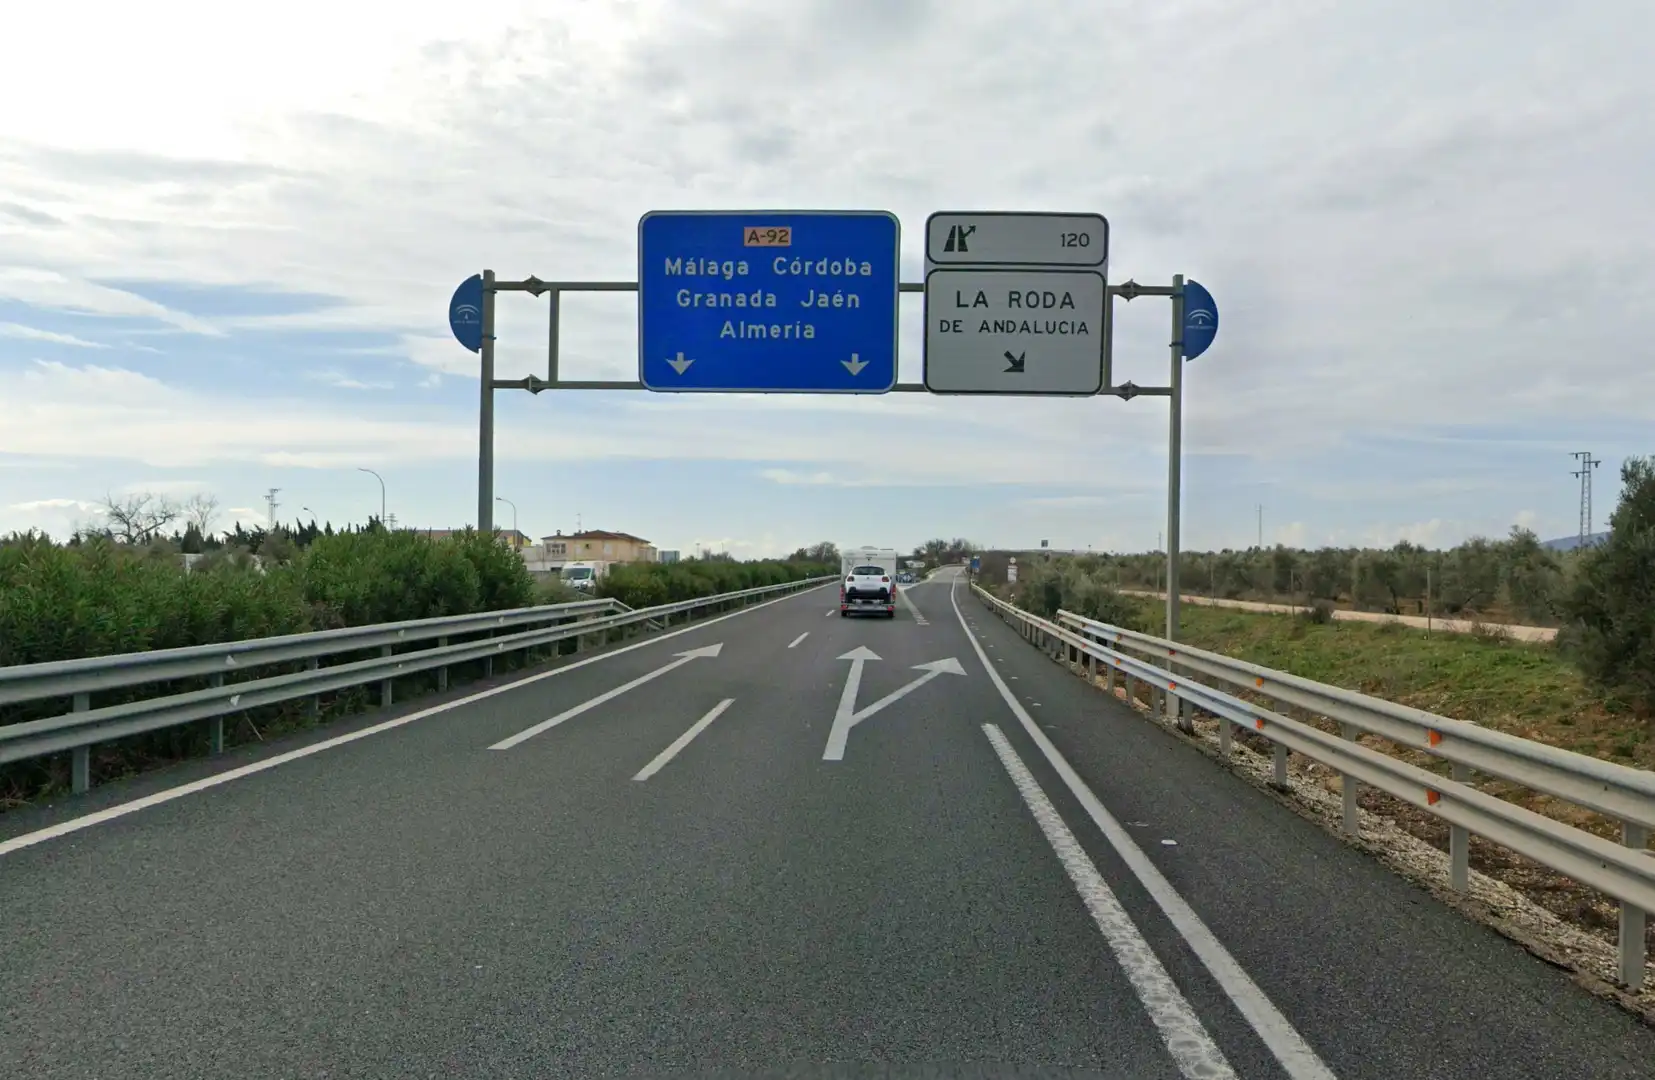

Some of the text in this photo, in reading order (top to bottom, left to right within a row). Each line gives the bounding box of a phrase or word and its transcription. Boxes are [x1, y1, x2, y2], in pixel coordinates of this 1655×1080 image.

[747, 229, 790, 244] A-92
[1060, 232, 1090, 248] 120
[664, 256, 873, 280] Málaga Córdoba
[676, 289, 860, 308] Granada Jaén
[956, 290, 1075, 309] LA RODA
[719, 320, 816, 339] Almería
[939, 319, 1089, 335] DE ANDALUCIA
